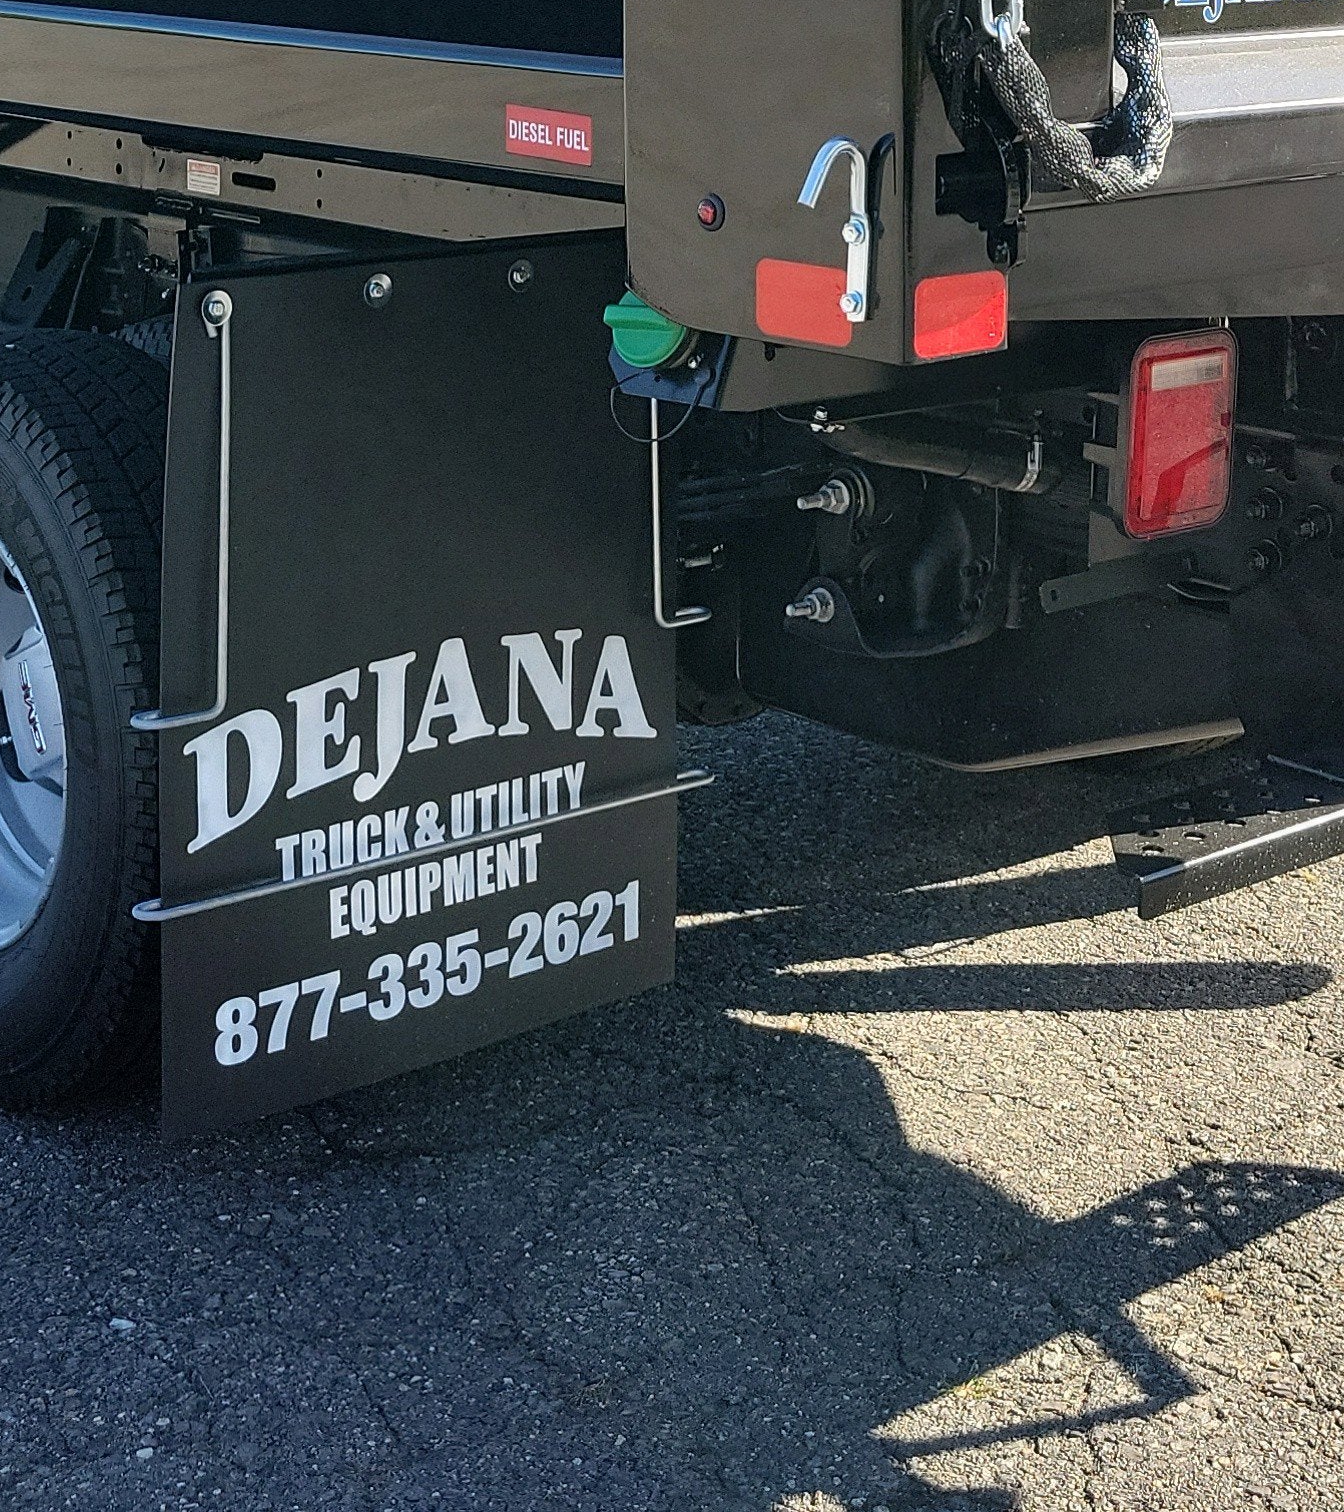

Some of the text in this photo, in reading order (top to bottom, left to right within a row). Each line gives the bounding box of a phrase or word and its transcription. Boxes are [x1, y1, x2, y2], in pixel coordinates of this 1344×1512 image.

[509, 119, 589, 152] DIESEL FUEL
[182, 628, 658, 854] DEJANA
[274, 761, 587, 883] TRUCK & UTILITY
[329, 834, 544, 940] EQUIPMENT
[213, 879, 643, 1067] 877-335-2621
